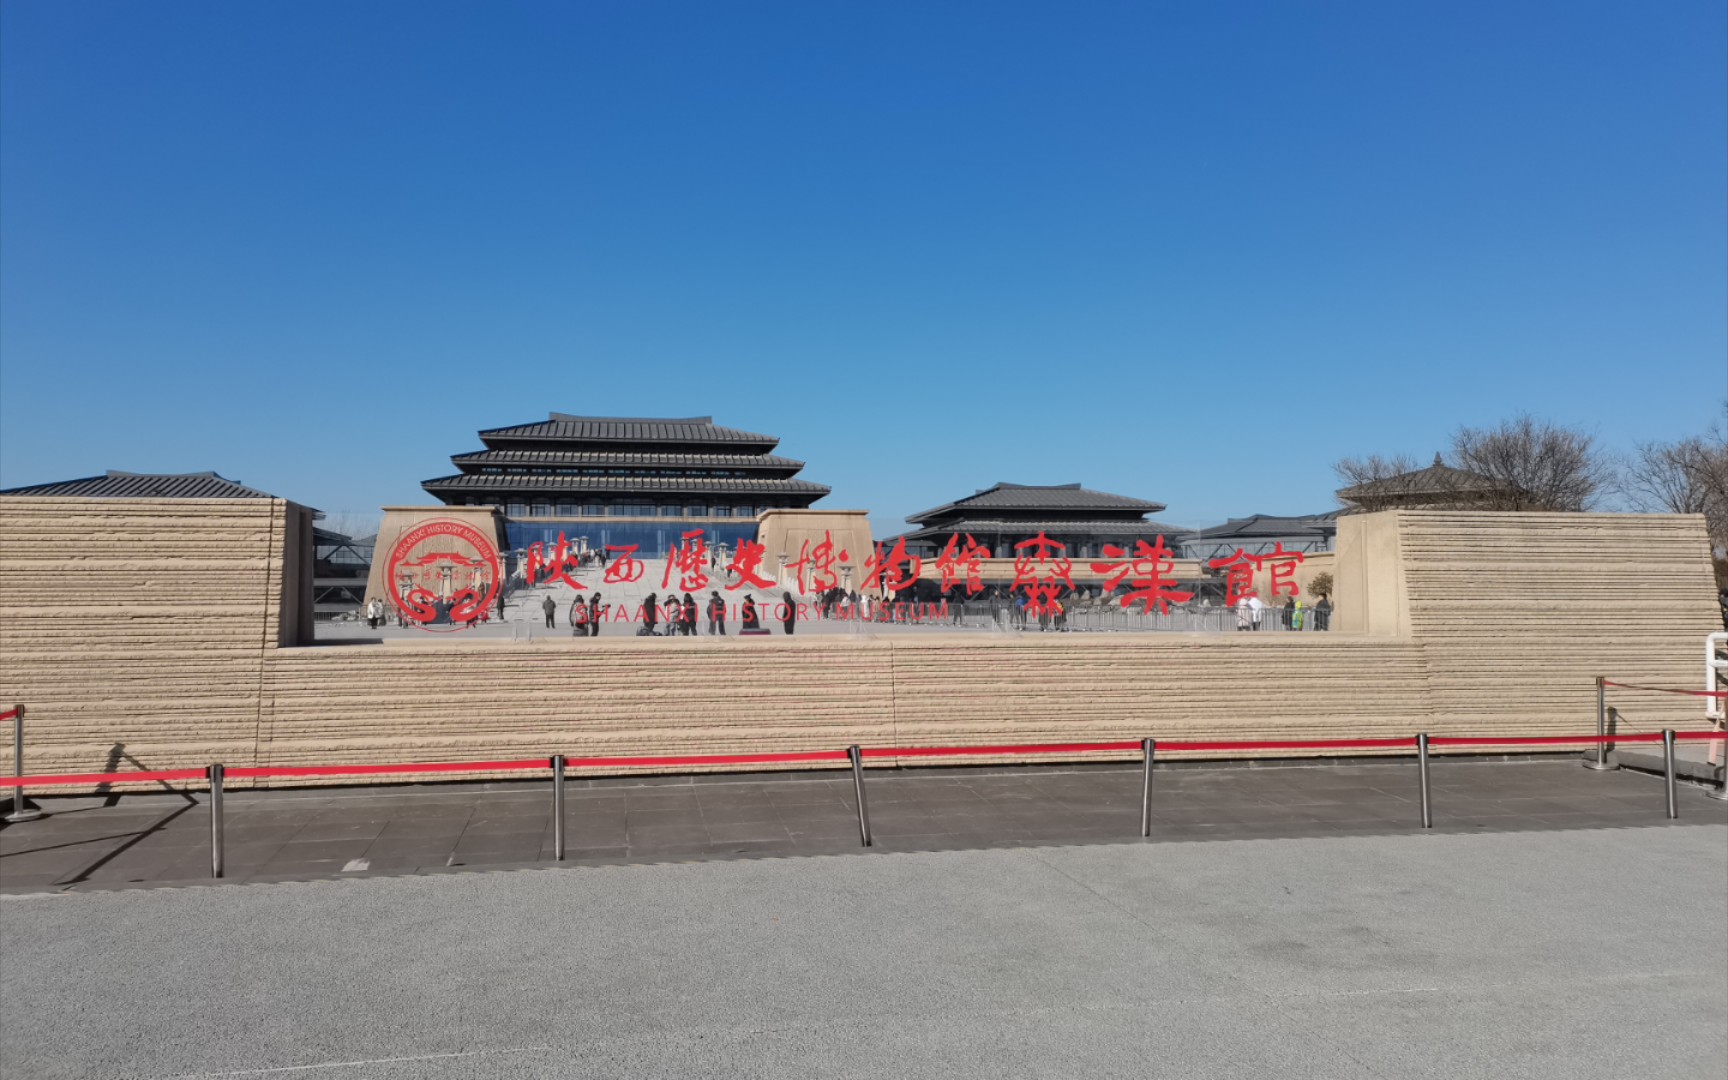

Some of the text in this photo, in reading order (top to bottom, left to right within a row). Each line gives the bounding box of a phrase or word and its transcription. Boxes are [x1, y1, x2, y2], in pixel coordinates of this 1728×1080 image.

[395, 523, 493, 559] SHAANXI HISTORY MUSEUM
[575, 601, 949, 624] SHAANXI HISTORY MUSEUM
